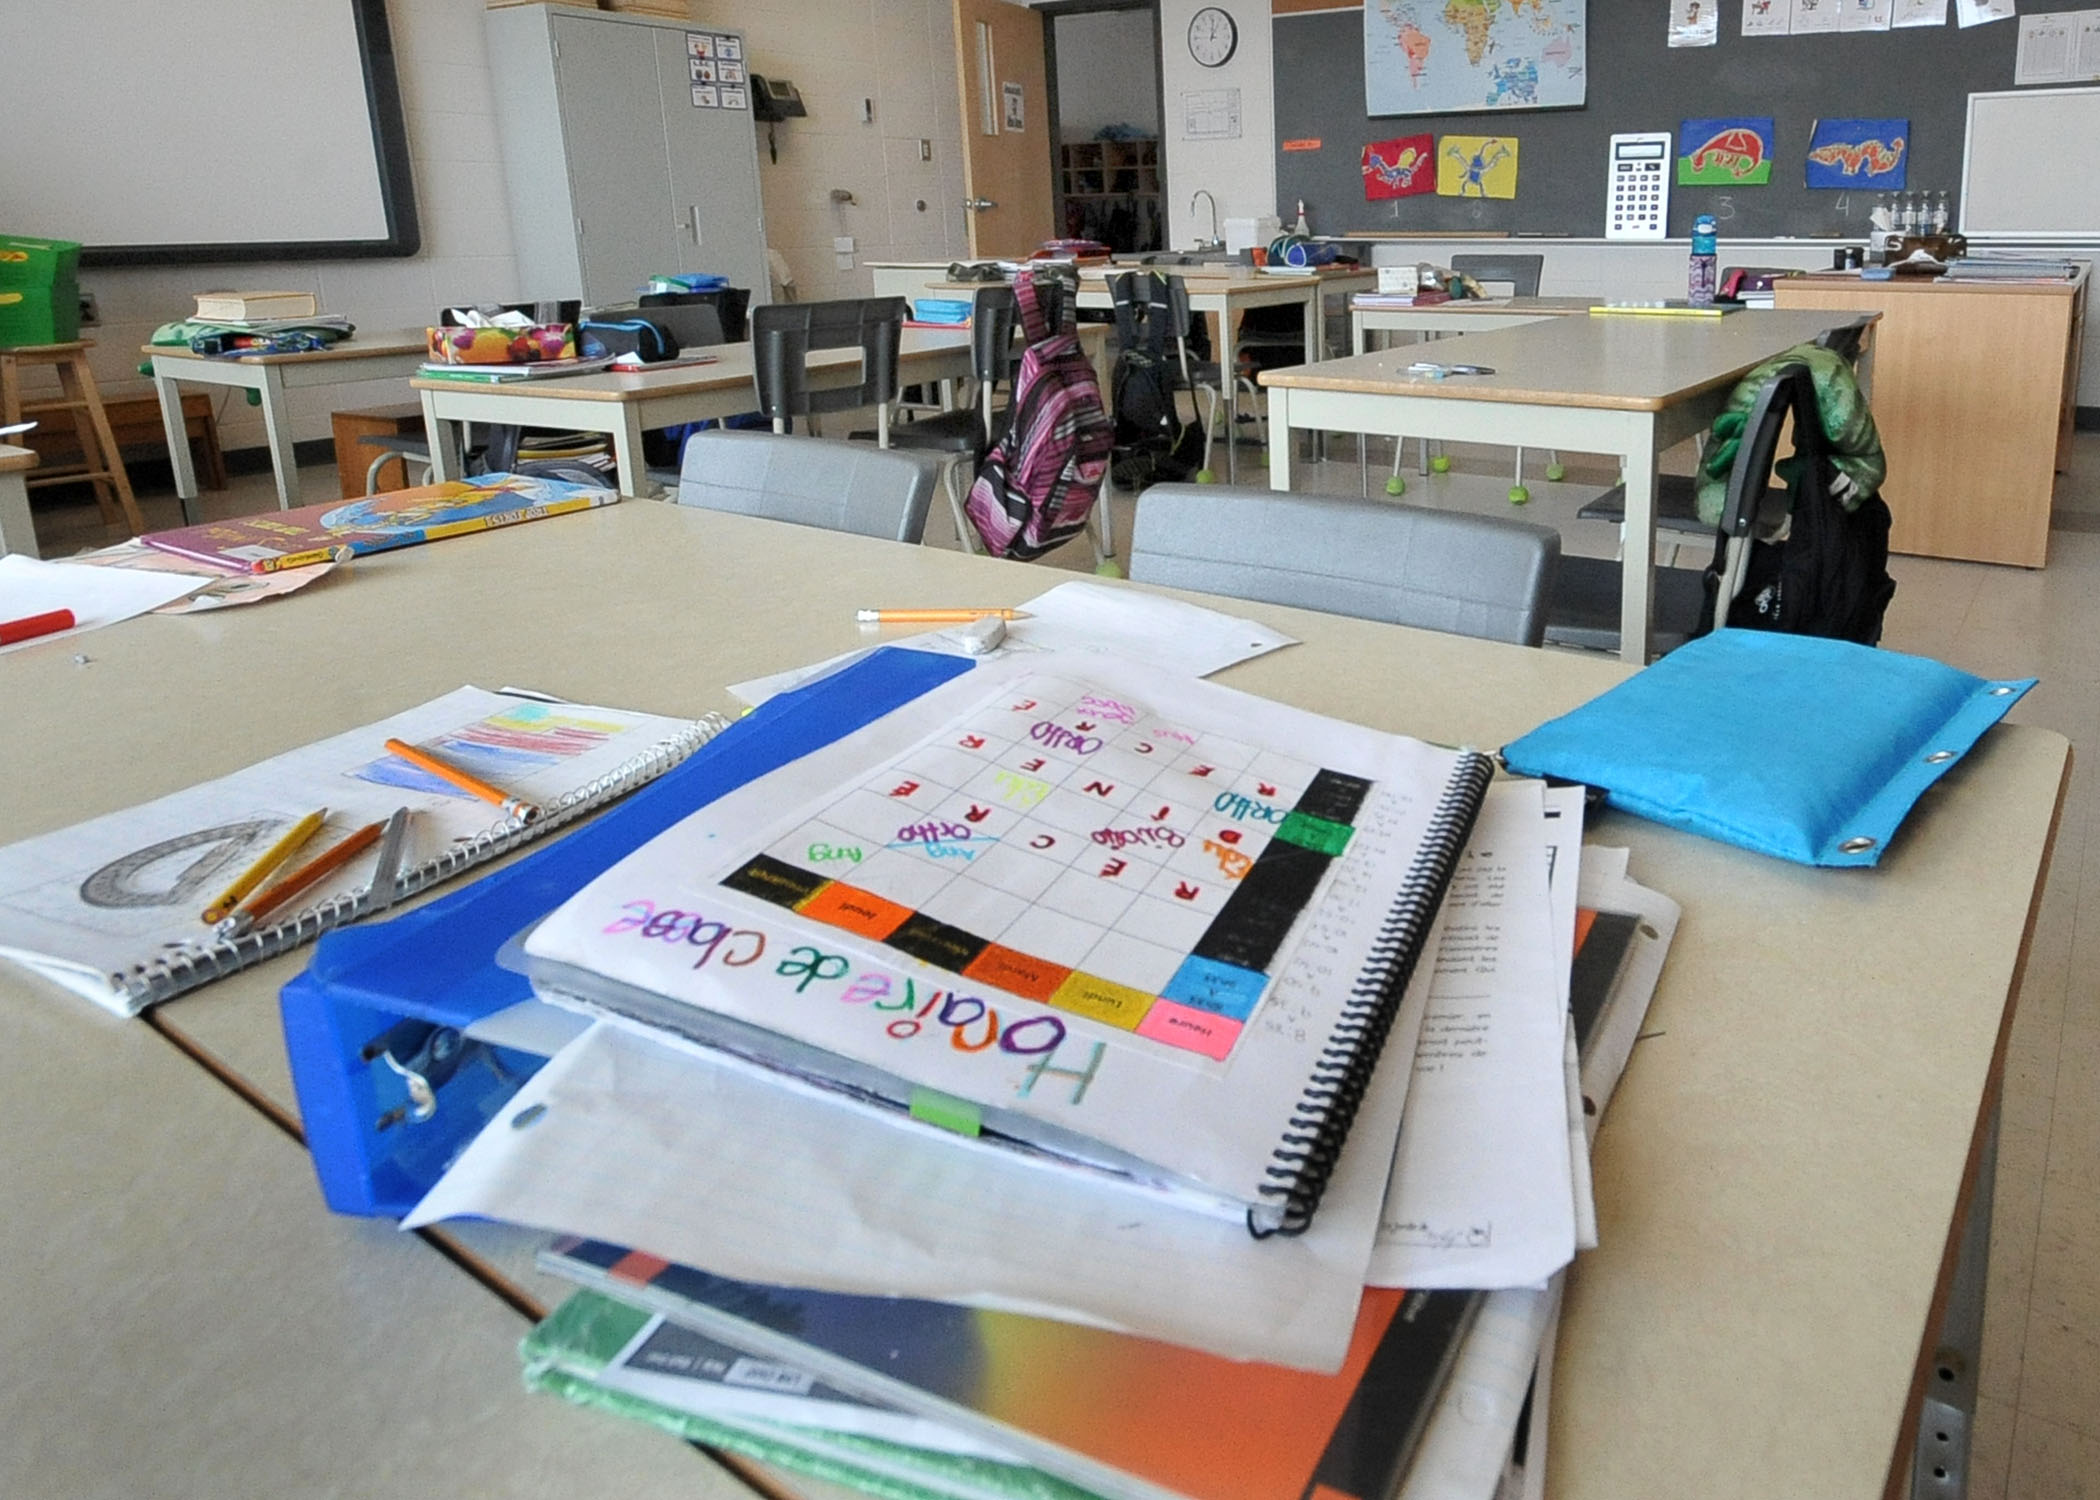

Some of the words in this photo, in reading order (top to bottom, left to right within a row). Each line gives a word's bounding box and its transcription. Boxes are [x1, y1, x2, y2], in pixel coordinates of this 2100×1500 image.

[1390, 201, 1399, 218] 1
[1718, 196, 1736, 219] 3
[1834, 192, 1851, 217] 4
[958, 734, 987, 750] R
[1020, 758, 1047, 773] E
[1083, 781, 1115, 797] N
[963, 803, 992, 825] R
[1030, 833, 1056, 850] C
[1219, 829, 1243, 845] D
[1174, 881, 1201, 901] R
[775, 946, 850, 993] de
[1082, 991, 1123, 1009] Lundi
[1168, 1016, 1214, 1038] Heure
